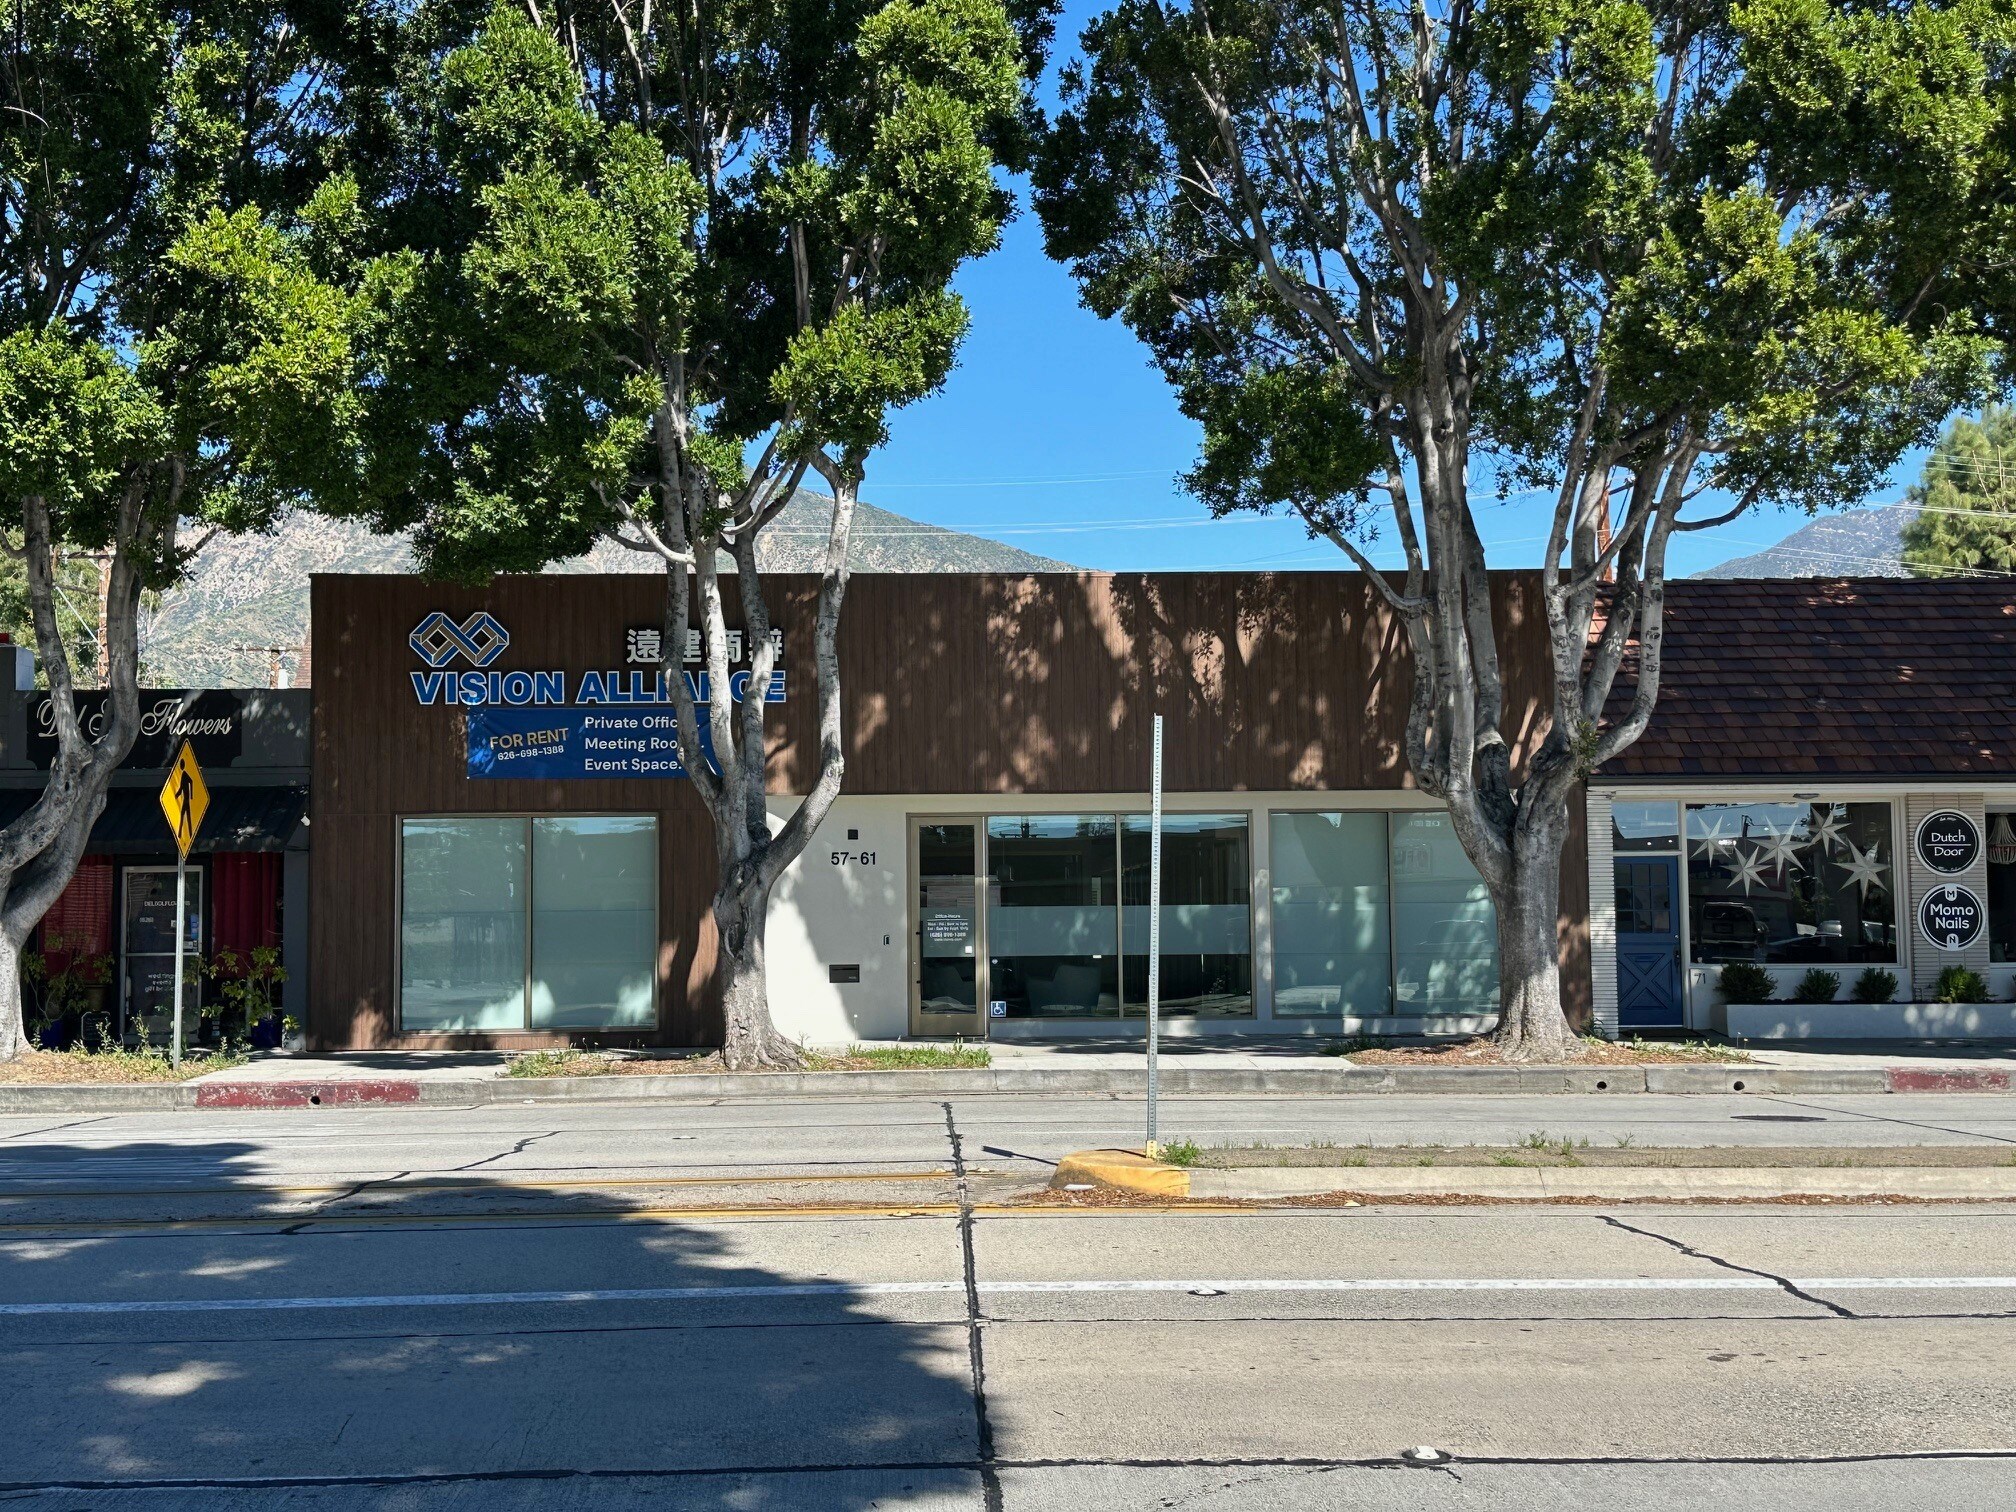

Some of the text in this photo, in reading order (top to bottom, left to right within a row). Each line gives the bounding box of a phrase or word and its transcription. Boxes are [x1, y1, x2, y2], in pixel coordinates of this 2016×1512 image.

[410, 671, 565, 705] VISION
[140, 698, 232, 736] Flowers
[584, 716, 700, 728] Private Offic.
[489, 727, 569, 750] FOR RENT
[584, 737, 704, 752] Meeting Roo.
[497, 745, 564, 761] 626-698-1388
[584, 758, 682, 773] Event Space.
[1931, 829, 1966, 842] Dutch
[1934, 847, 1964, 857] Door
[831, 852, 876, 866] 57-61
[1947, 890, 1955, 898] M
[1930, 904, 1974, 916] Momo
[1935, 917, 1970, 929] Nails
[1949, 936, 1956, 944] N
[1693, 973, 1707, 985] 71
